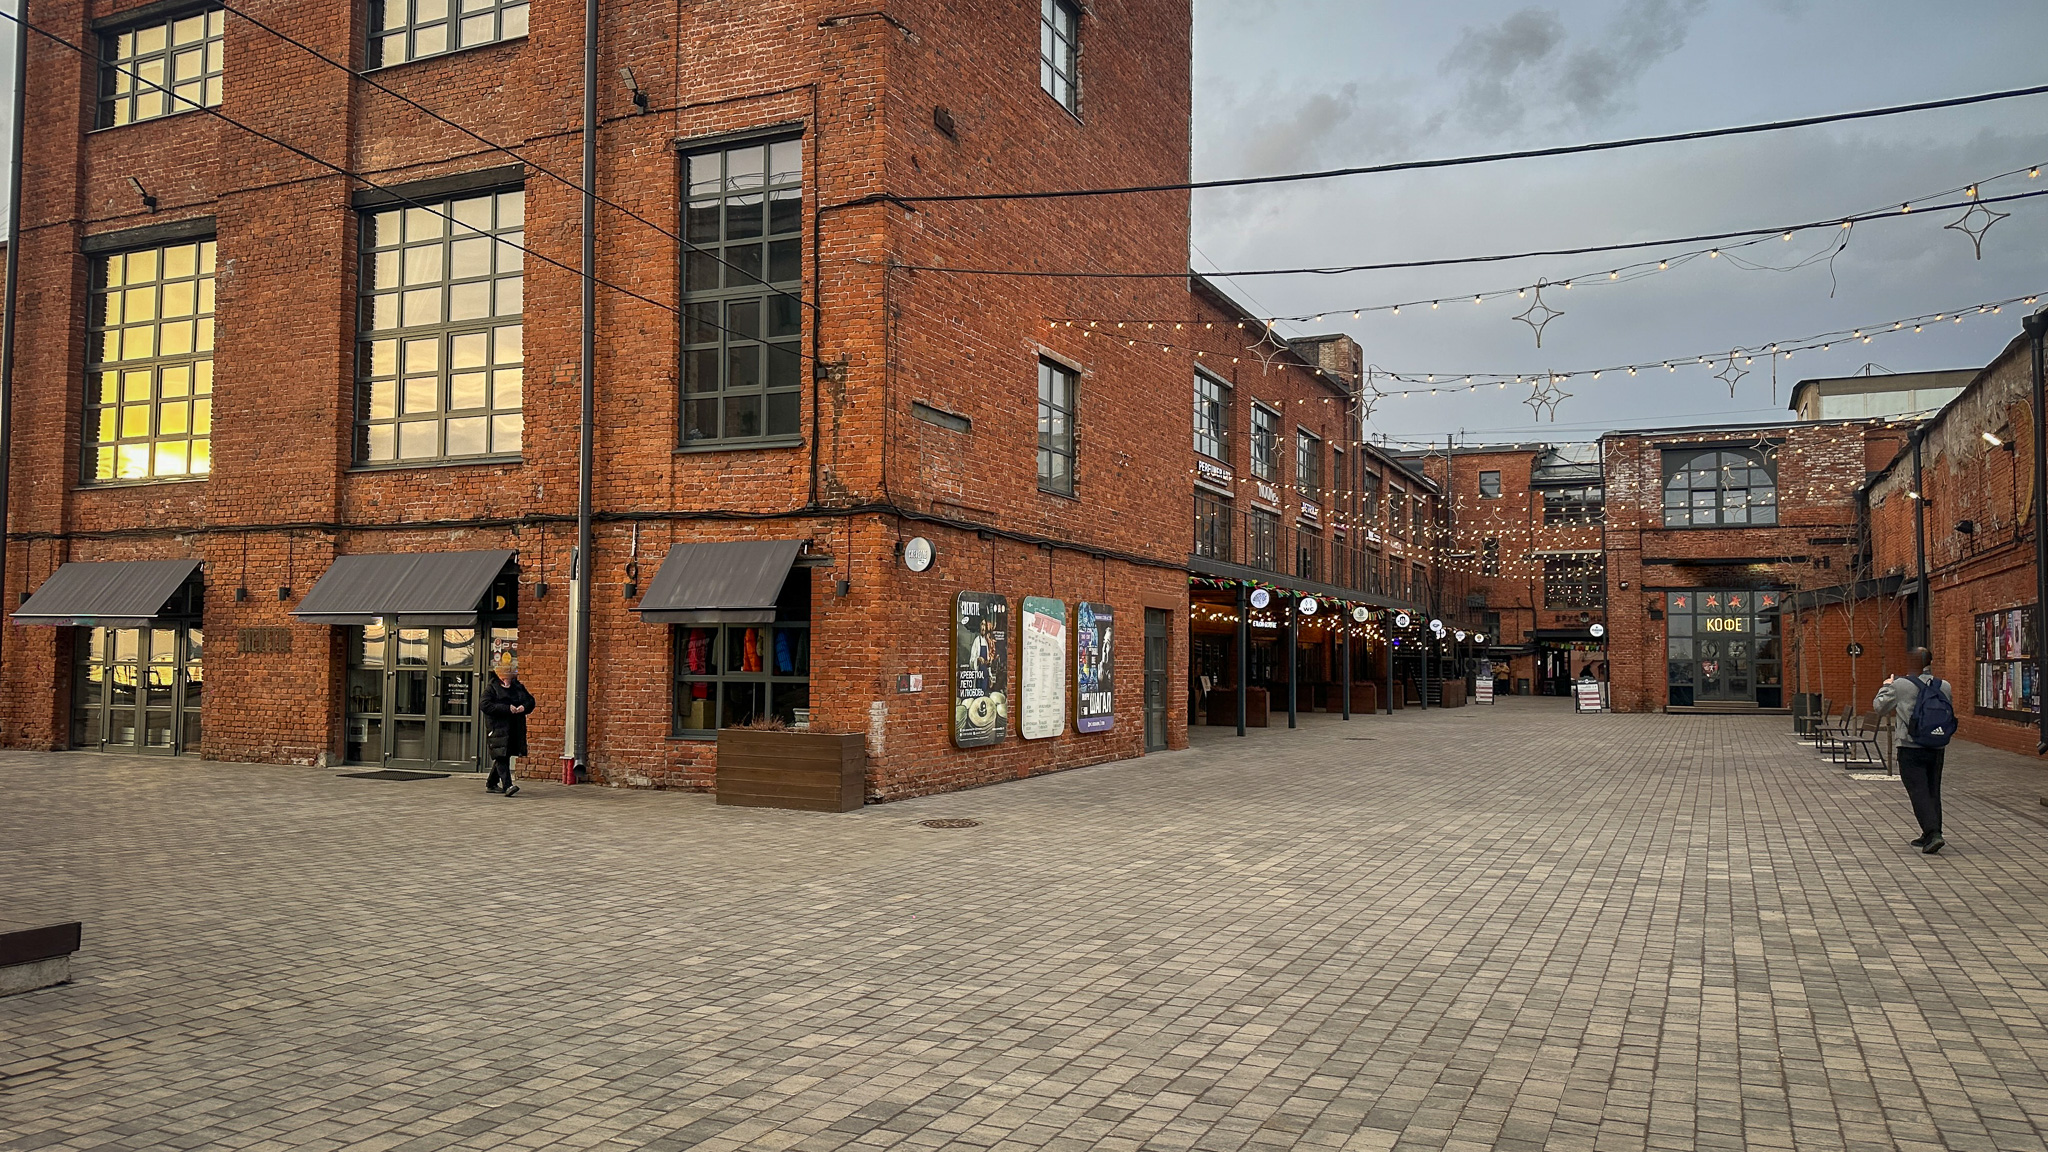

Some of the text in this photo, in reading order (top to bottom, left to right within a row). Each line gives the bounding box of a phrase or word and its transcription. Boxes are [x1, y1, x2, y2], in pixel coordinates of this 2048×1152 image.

[1706, 617, 1743, 632] КОФЕ
[959, 679, 973, 689] ЛЕТО
[964, 688, 985, 697] ЛЮБОВЬ
[1089, 691, 1112, 715] ШАГАЛ
